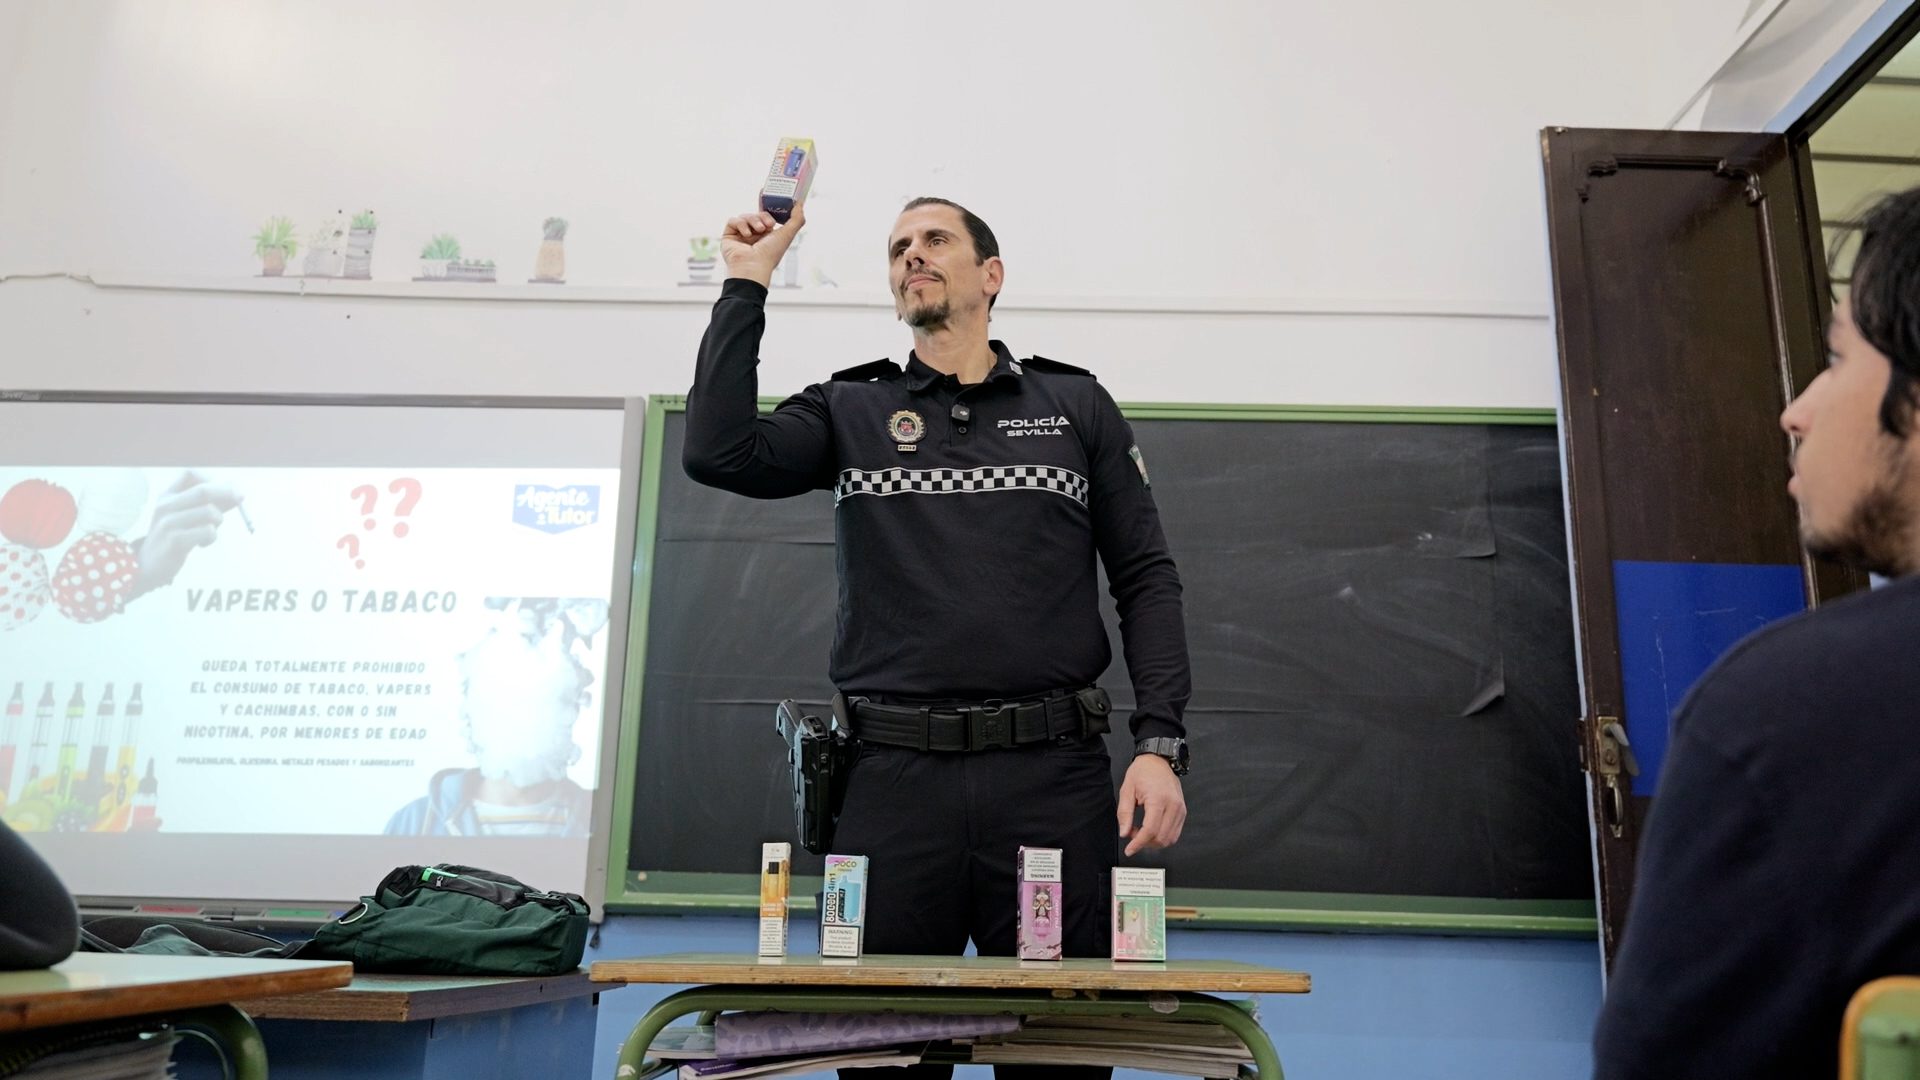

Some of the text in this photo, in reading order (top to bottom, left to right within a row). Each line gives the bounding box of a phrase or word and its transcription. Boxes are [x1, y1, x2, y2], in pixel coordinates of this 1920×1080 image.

[997, 416, 1070, 428] POLICÍA
[1006, 428, 1062, 437] SEVILLA
[516, 486, 590, 512] Agente
[545, 505, 595, 525] Tutor
[186, 588, 457, 613] VAPERS O TABACO
[201, 660, 426, 674] QUEDA TOTALMENTE PROHIBIDO
[190, 682, 432, 696] EL CONSUMO DE TABACO, VAPERS
[219, 704, 398, 718] Y CACHIMBAS, CON O SIN
[184, 725, 427, 740] NICOTINA, POR MENORES DE EDAD
[833, 860, 857, 868] POCO
